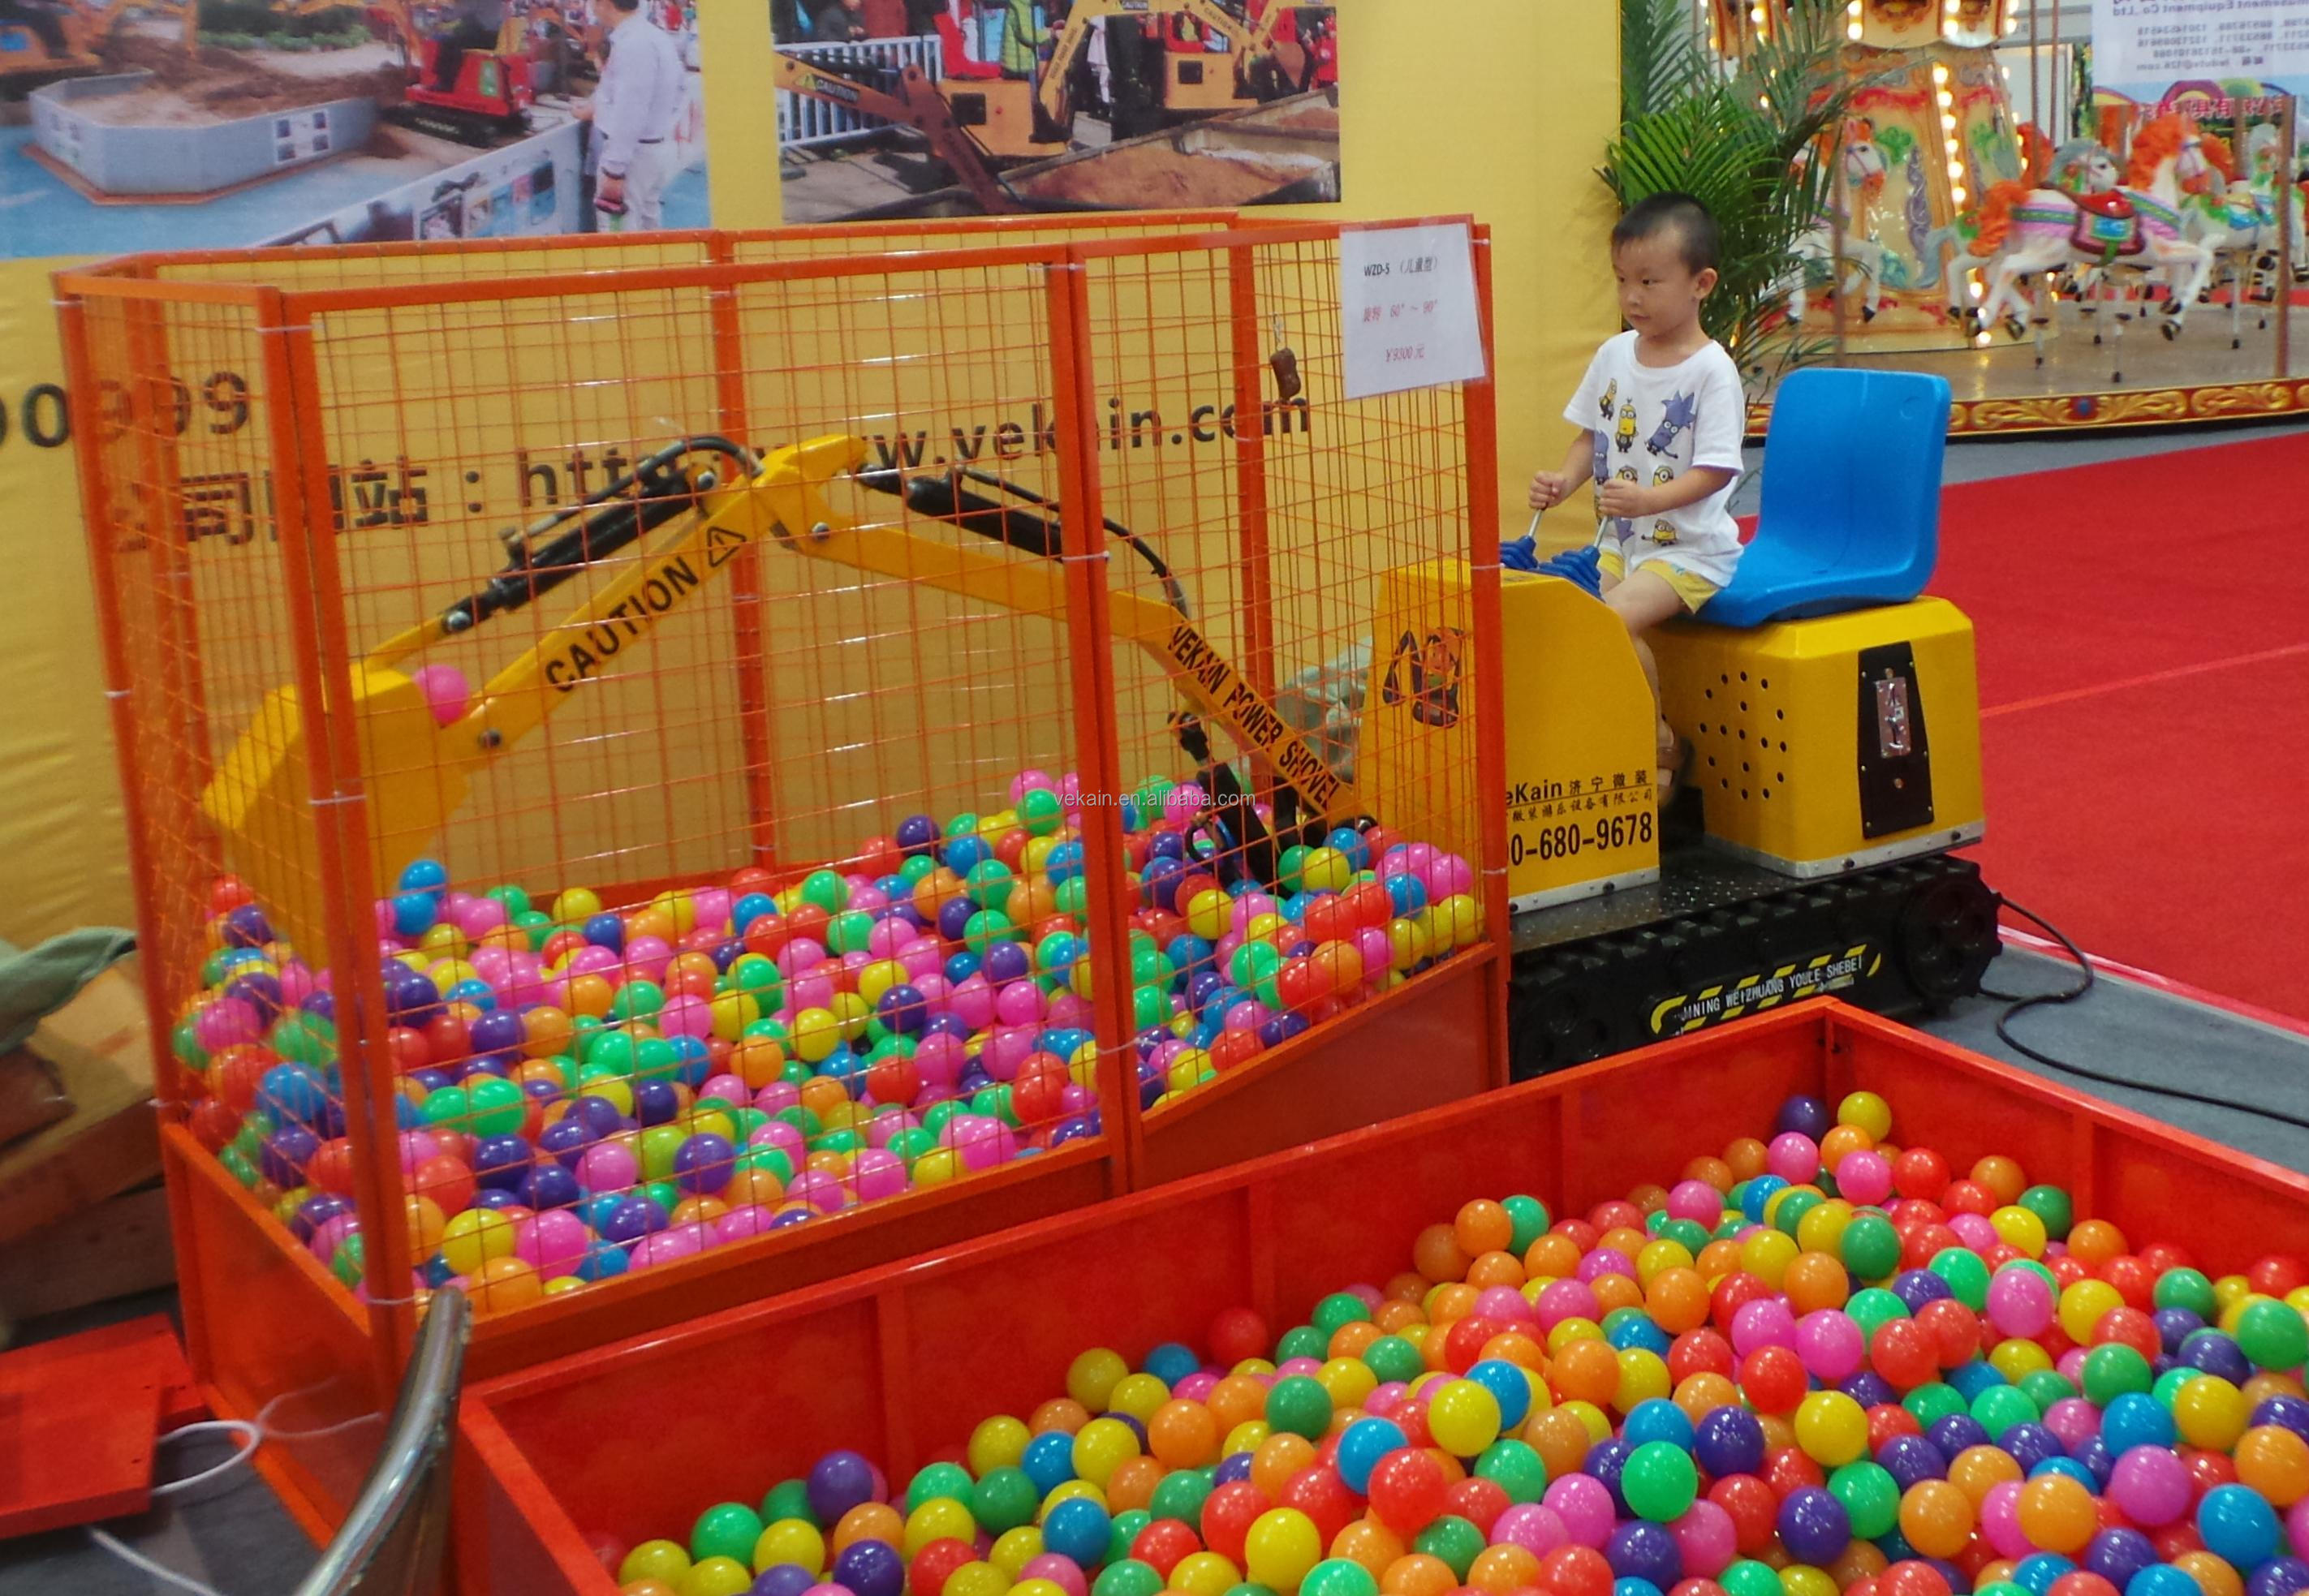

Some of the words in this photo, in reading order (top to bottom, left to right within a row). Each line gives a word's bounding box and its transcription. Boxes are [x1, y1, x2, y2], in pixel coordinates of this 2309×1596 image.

[1363, 262, 1389, 277] WZD-5
[545, 556, 699, 692] CAUTION
[1167, 625, 1230, 695] VEKAIN
[1222, 682, 1284, 753] POWER
[1506, 779, 1562, 806] eKain
[1507, 811, 1652, 867] 0-680-9678
[1725, 979, 1784, 1008] WEIZHUANG
[1790, 968, 1820, 988] YOULE
[1827, 954, 1862, 979] SHEBEI
